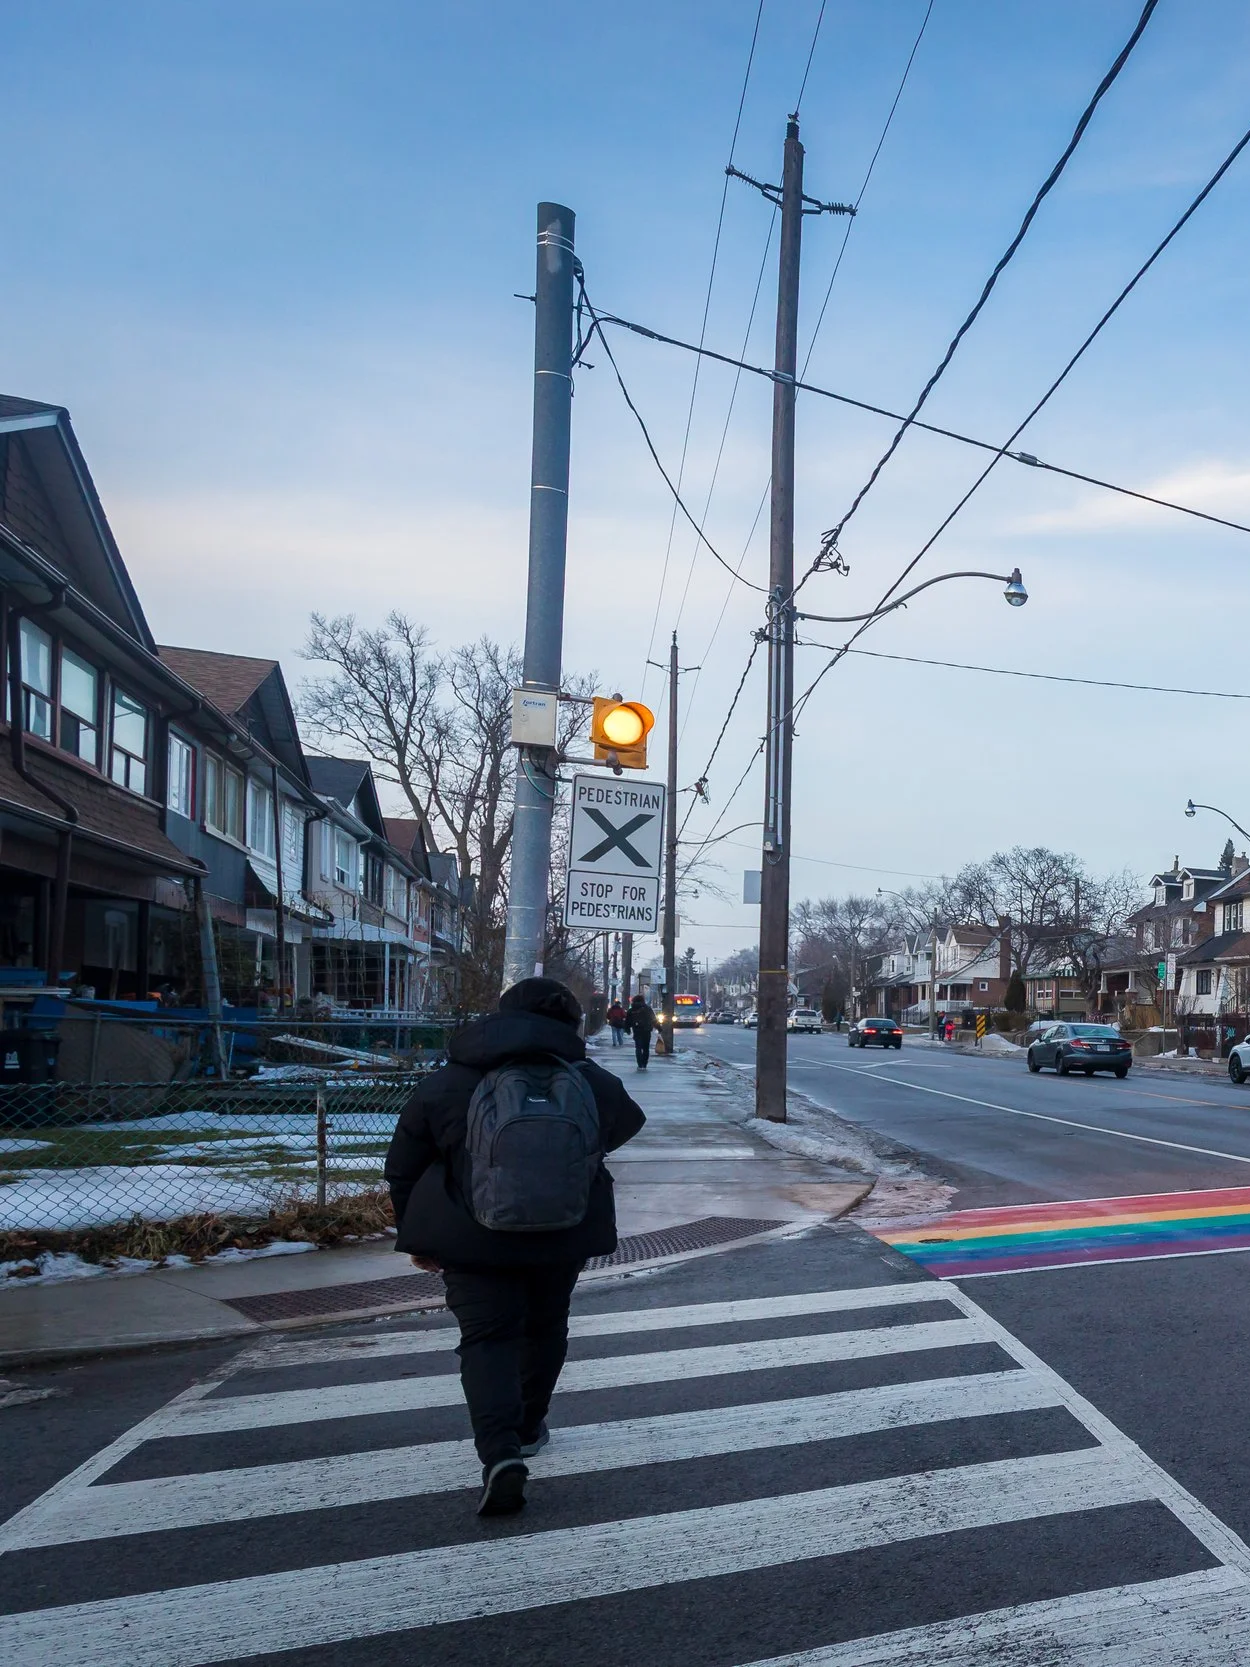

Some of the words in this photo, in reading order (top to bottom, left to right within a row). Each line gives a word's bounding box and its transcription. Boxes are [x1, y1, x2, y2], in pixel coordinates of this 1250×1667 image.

[579, 786, 660, 810] PEDESTRIAN
[580, 882, 613, 898] STOP
[622, 885, 647, 901] FOR
[571, 901, 653, 922] PEDESTRIANS
